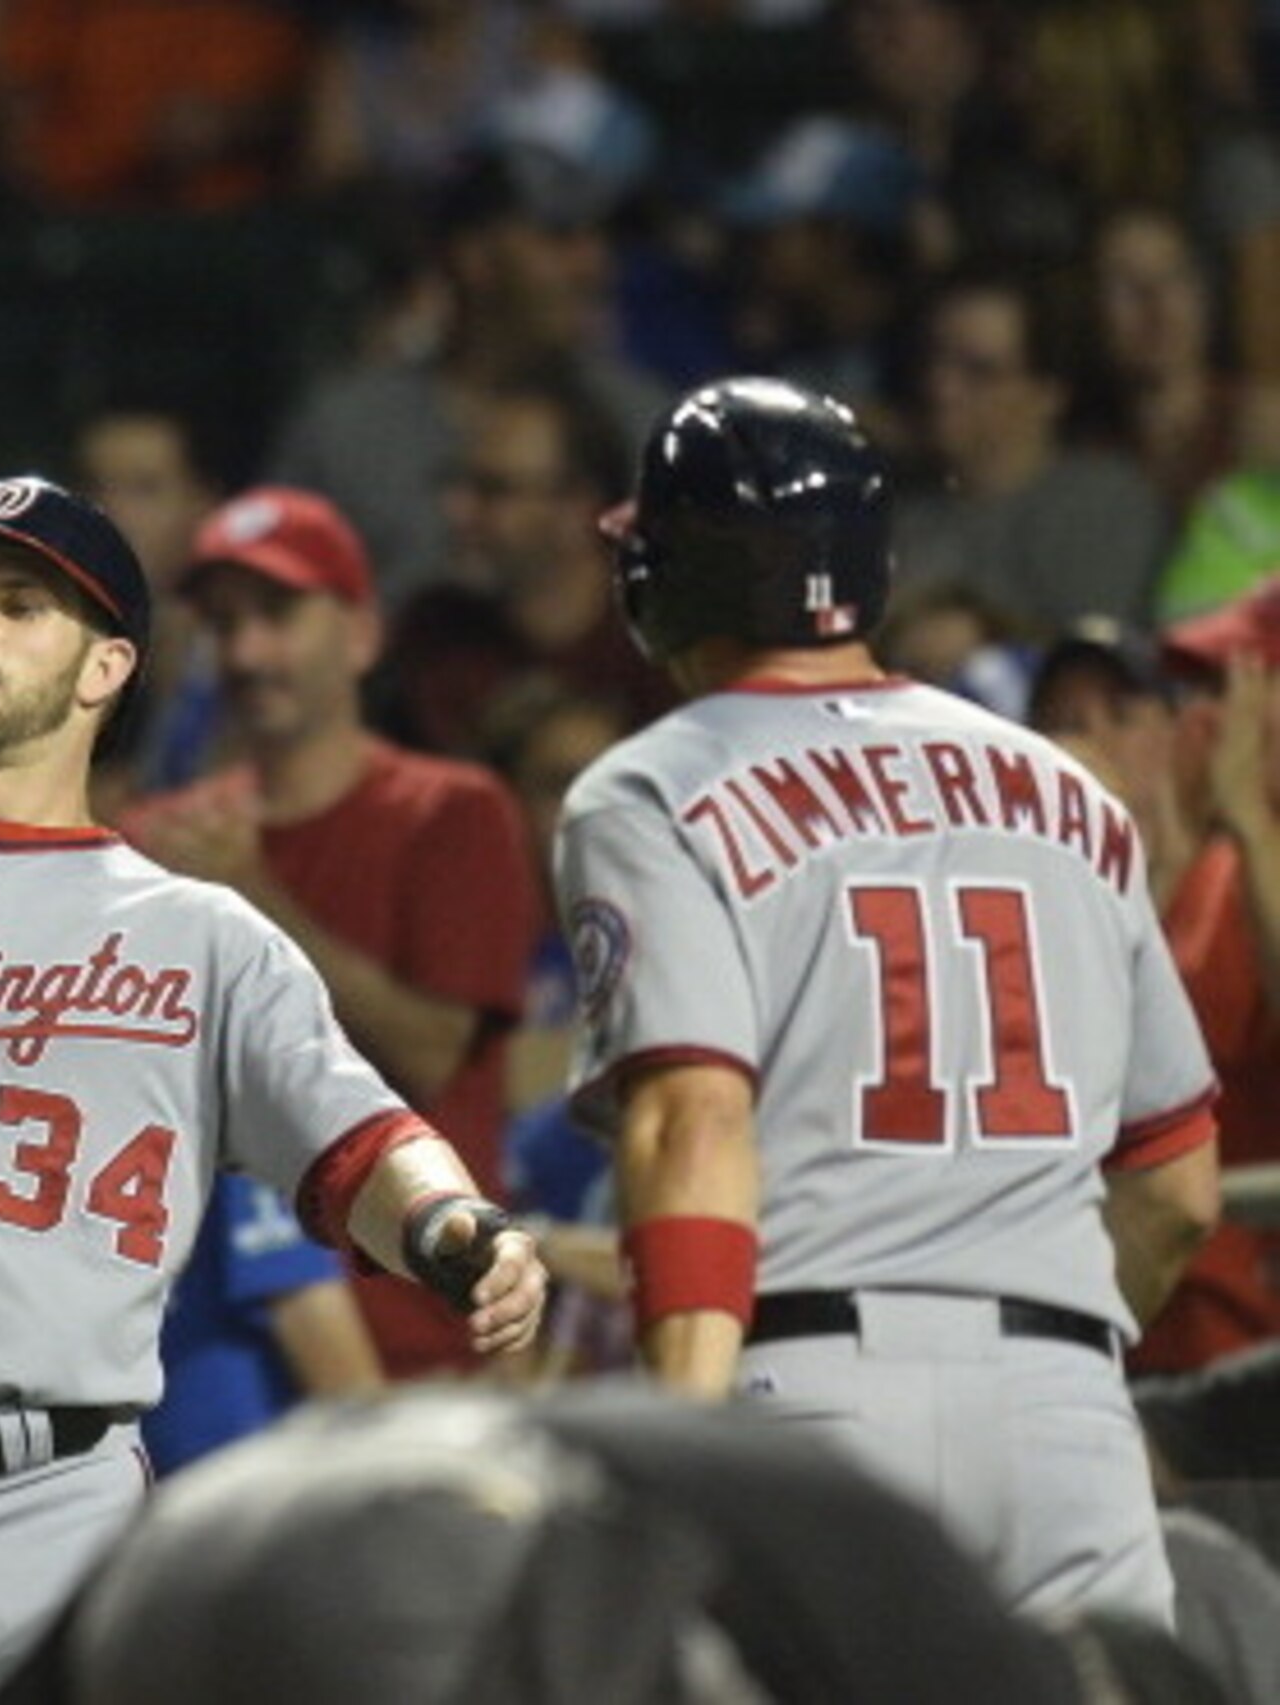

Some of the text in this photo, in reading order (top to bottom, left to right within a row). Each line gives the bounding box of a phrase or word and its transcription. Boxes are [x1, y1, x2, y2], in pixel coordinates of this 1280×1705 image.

[805, 573, 832, 612] 11
[680, 740, 1139, 901] ZIMMERMAN
[843, 878, 1078, 1153] 11
